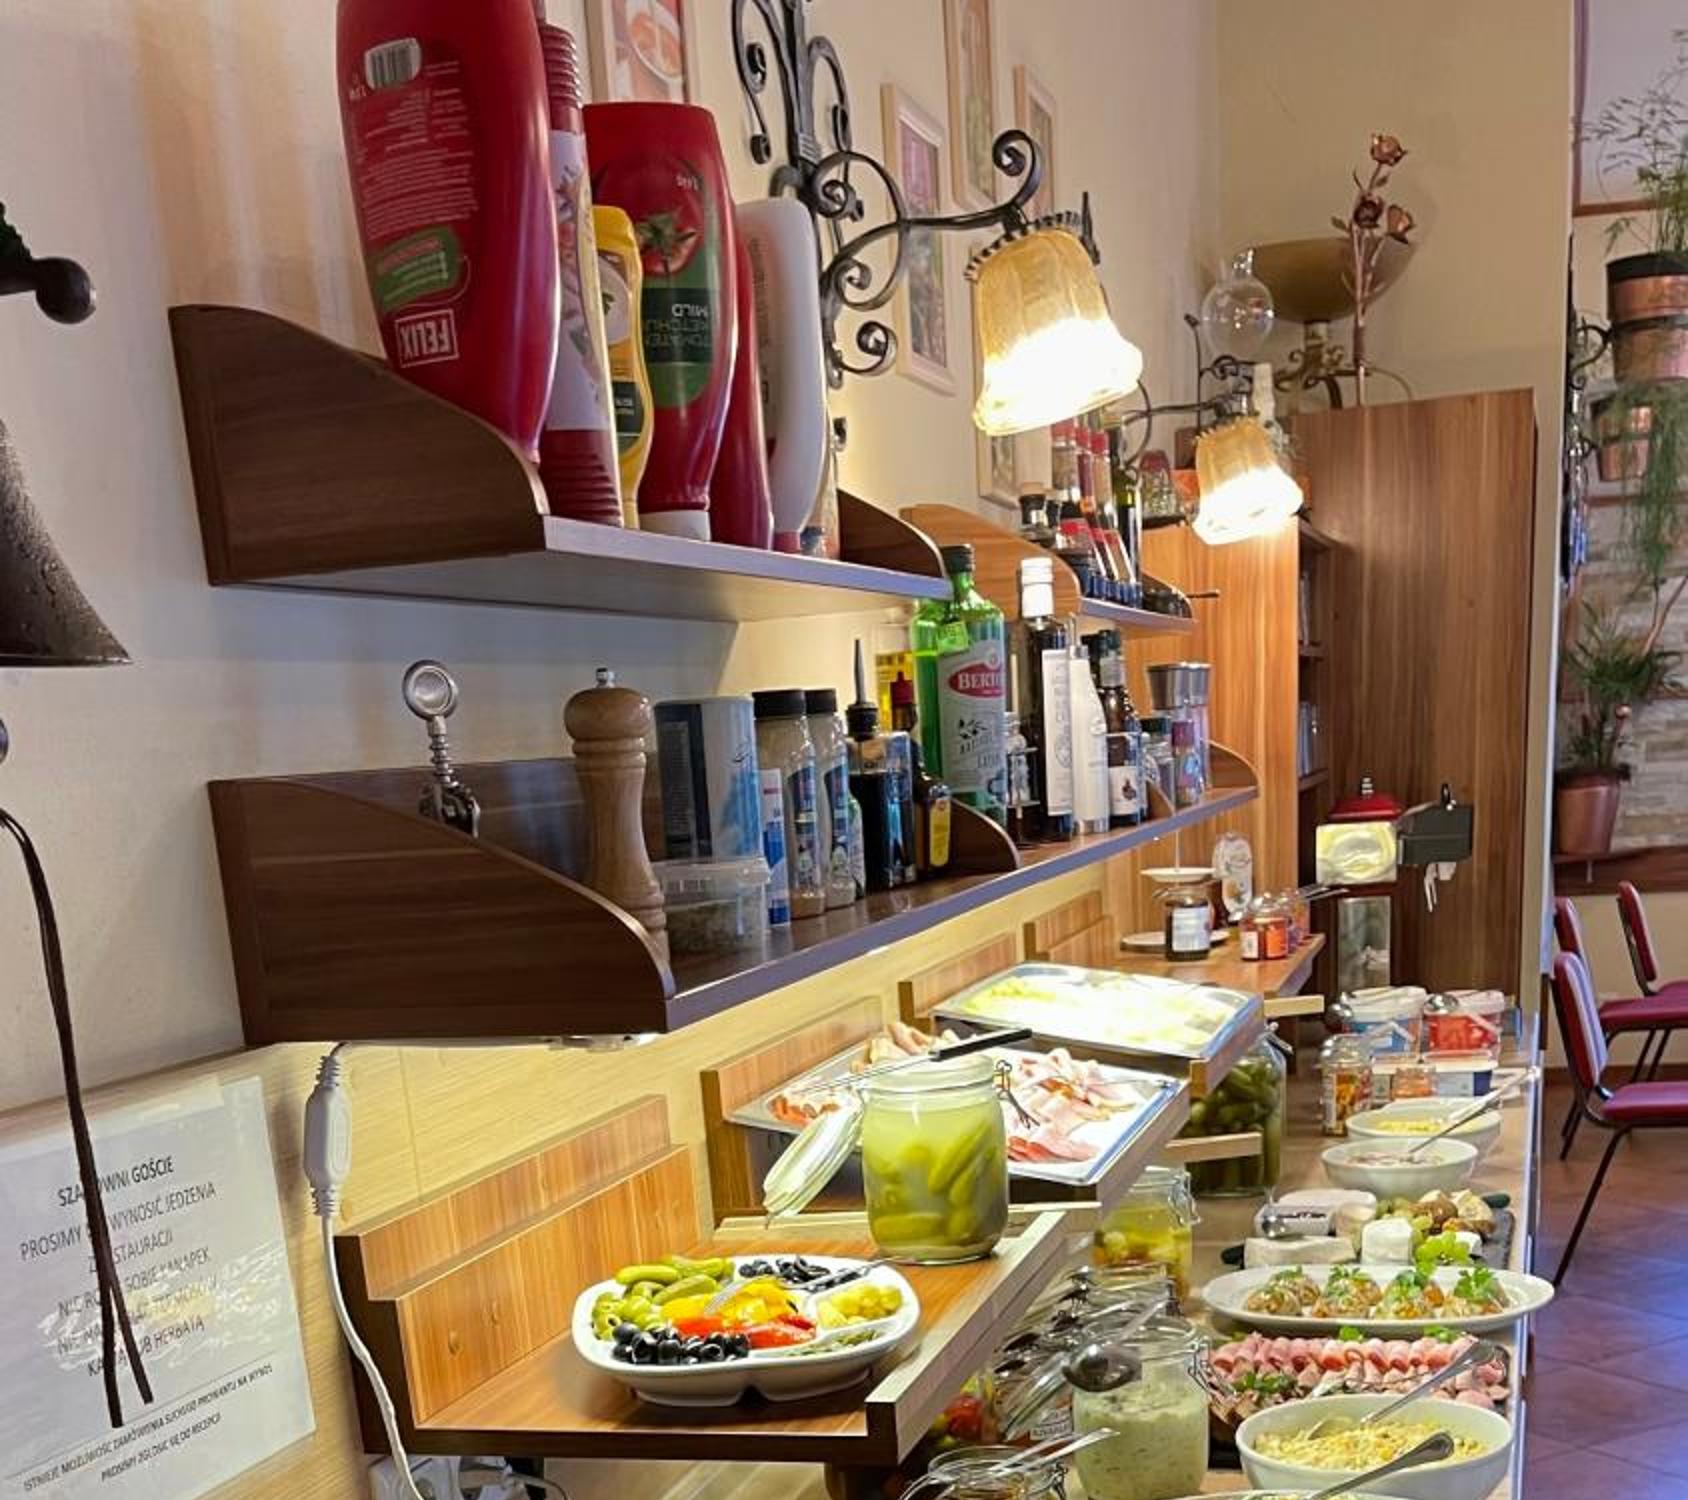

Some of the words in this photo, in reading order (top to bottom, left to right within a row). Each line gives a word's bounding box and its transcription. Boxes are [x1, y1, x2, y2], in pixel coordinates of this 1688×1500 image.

[671, 303, 709, 317] MILD
[400, 319, 450, 361] FELIX
[131, 1155, 174, 1184] GOŚCIE
[20, 1226, 82, 1260] PROSIMY
[165, 1180, 216, 1212] JEDZENIA
